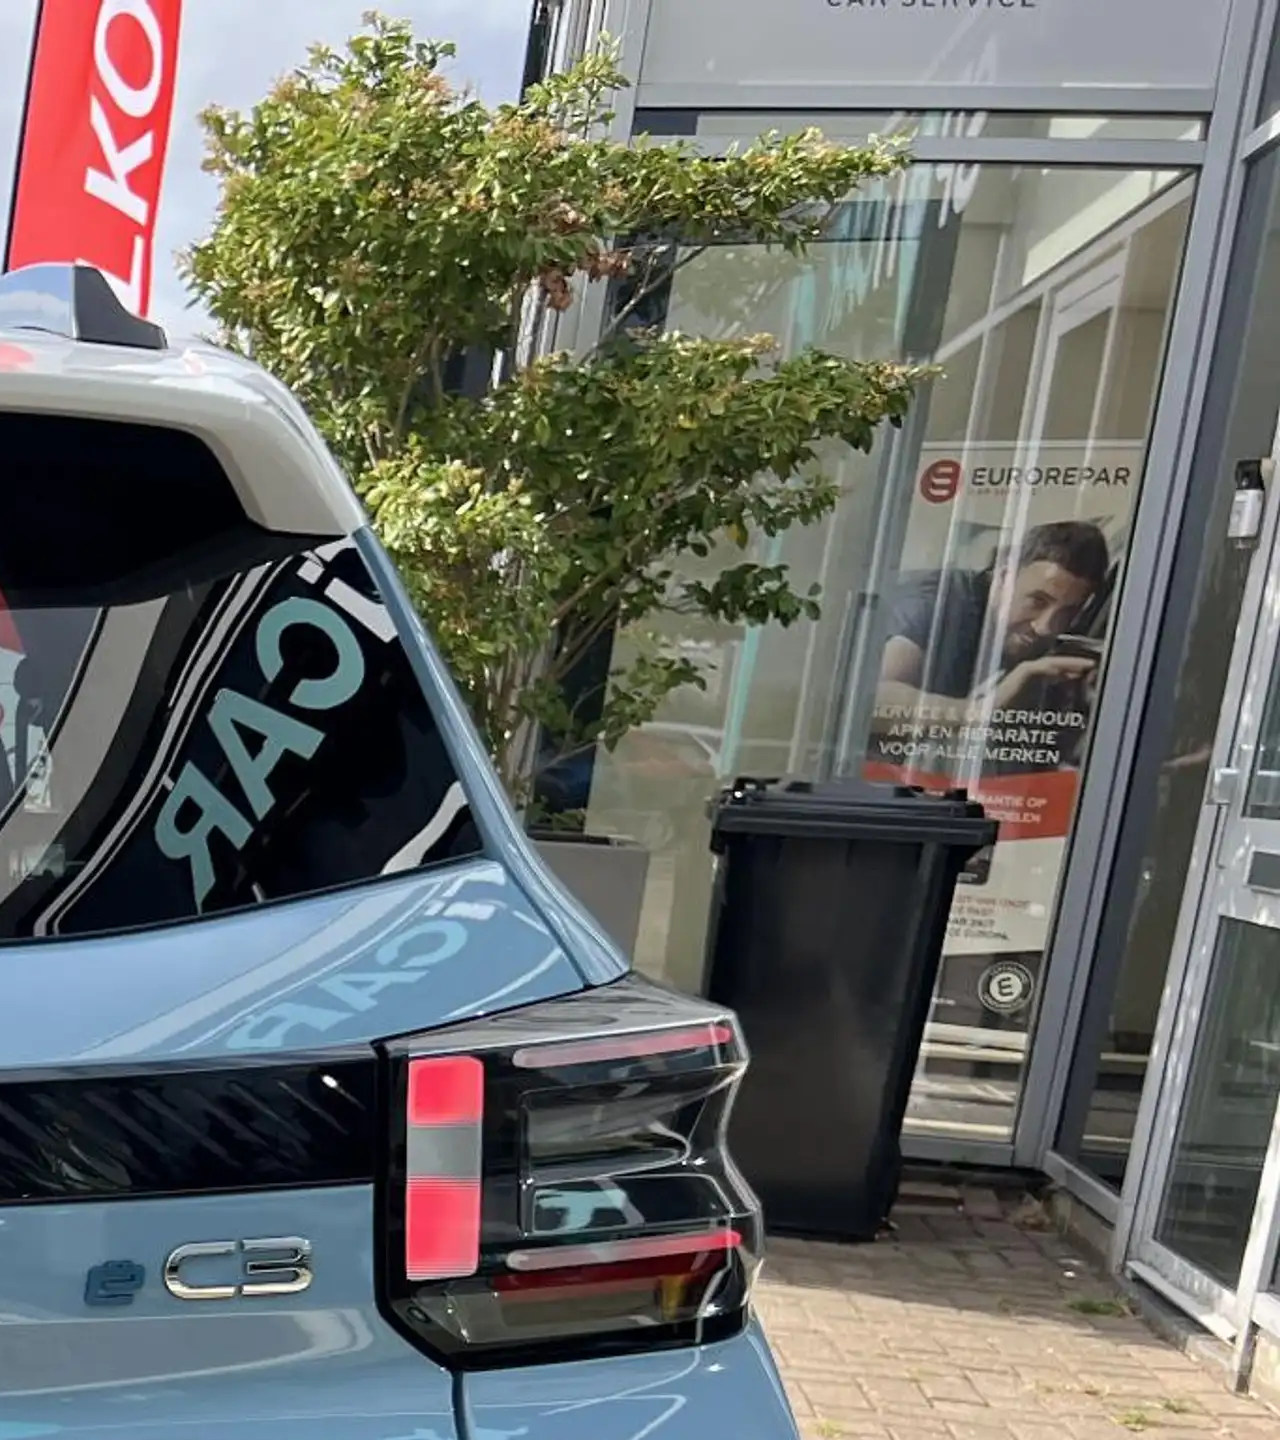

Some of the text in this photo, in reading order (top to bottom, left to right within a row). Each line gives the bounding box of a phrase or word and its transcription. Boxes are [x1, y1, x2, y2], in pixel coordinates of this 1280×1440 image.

[971, 467, 1131, 487] EUROREPAR
[888, 724, 1058, 745] APK EN REPARATIE
[878, 741, 930, 757] VOOR
[985, 747, 1060, 764] MERKEN
[163, 1235, 314, 1301] C3
